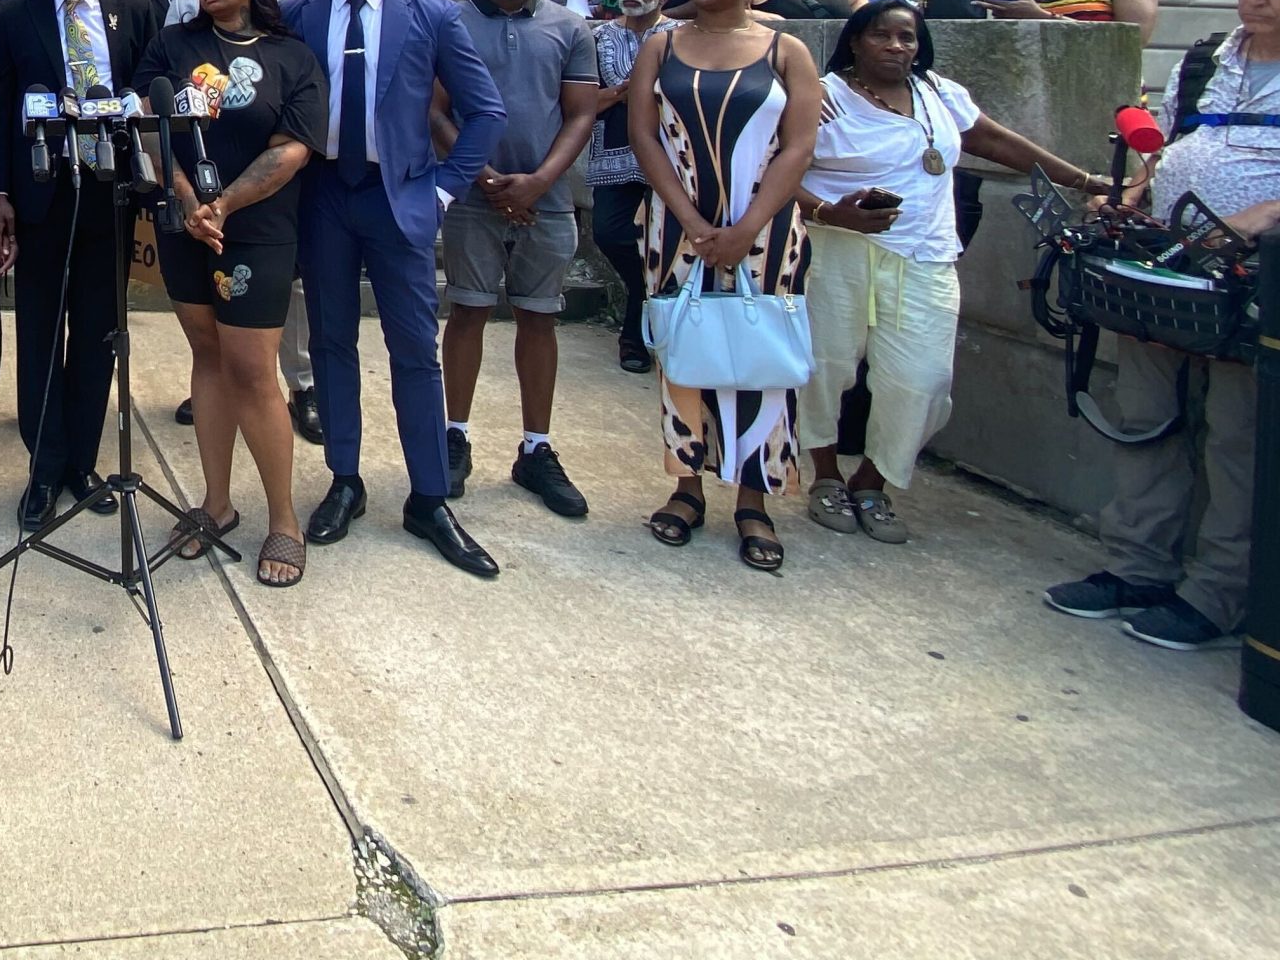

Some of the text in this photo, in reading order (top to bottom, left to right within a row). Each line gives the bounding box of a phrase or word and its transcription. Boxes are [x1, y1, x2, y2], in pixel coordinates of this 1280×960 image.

[97, 100, 122, 114] 58
[178, 100, 188, 113] 6
[1156, 242, 1184, 264] SOUND
